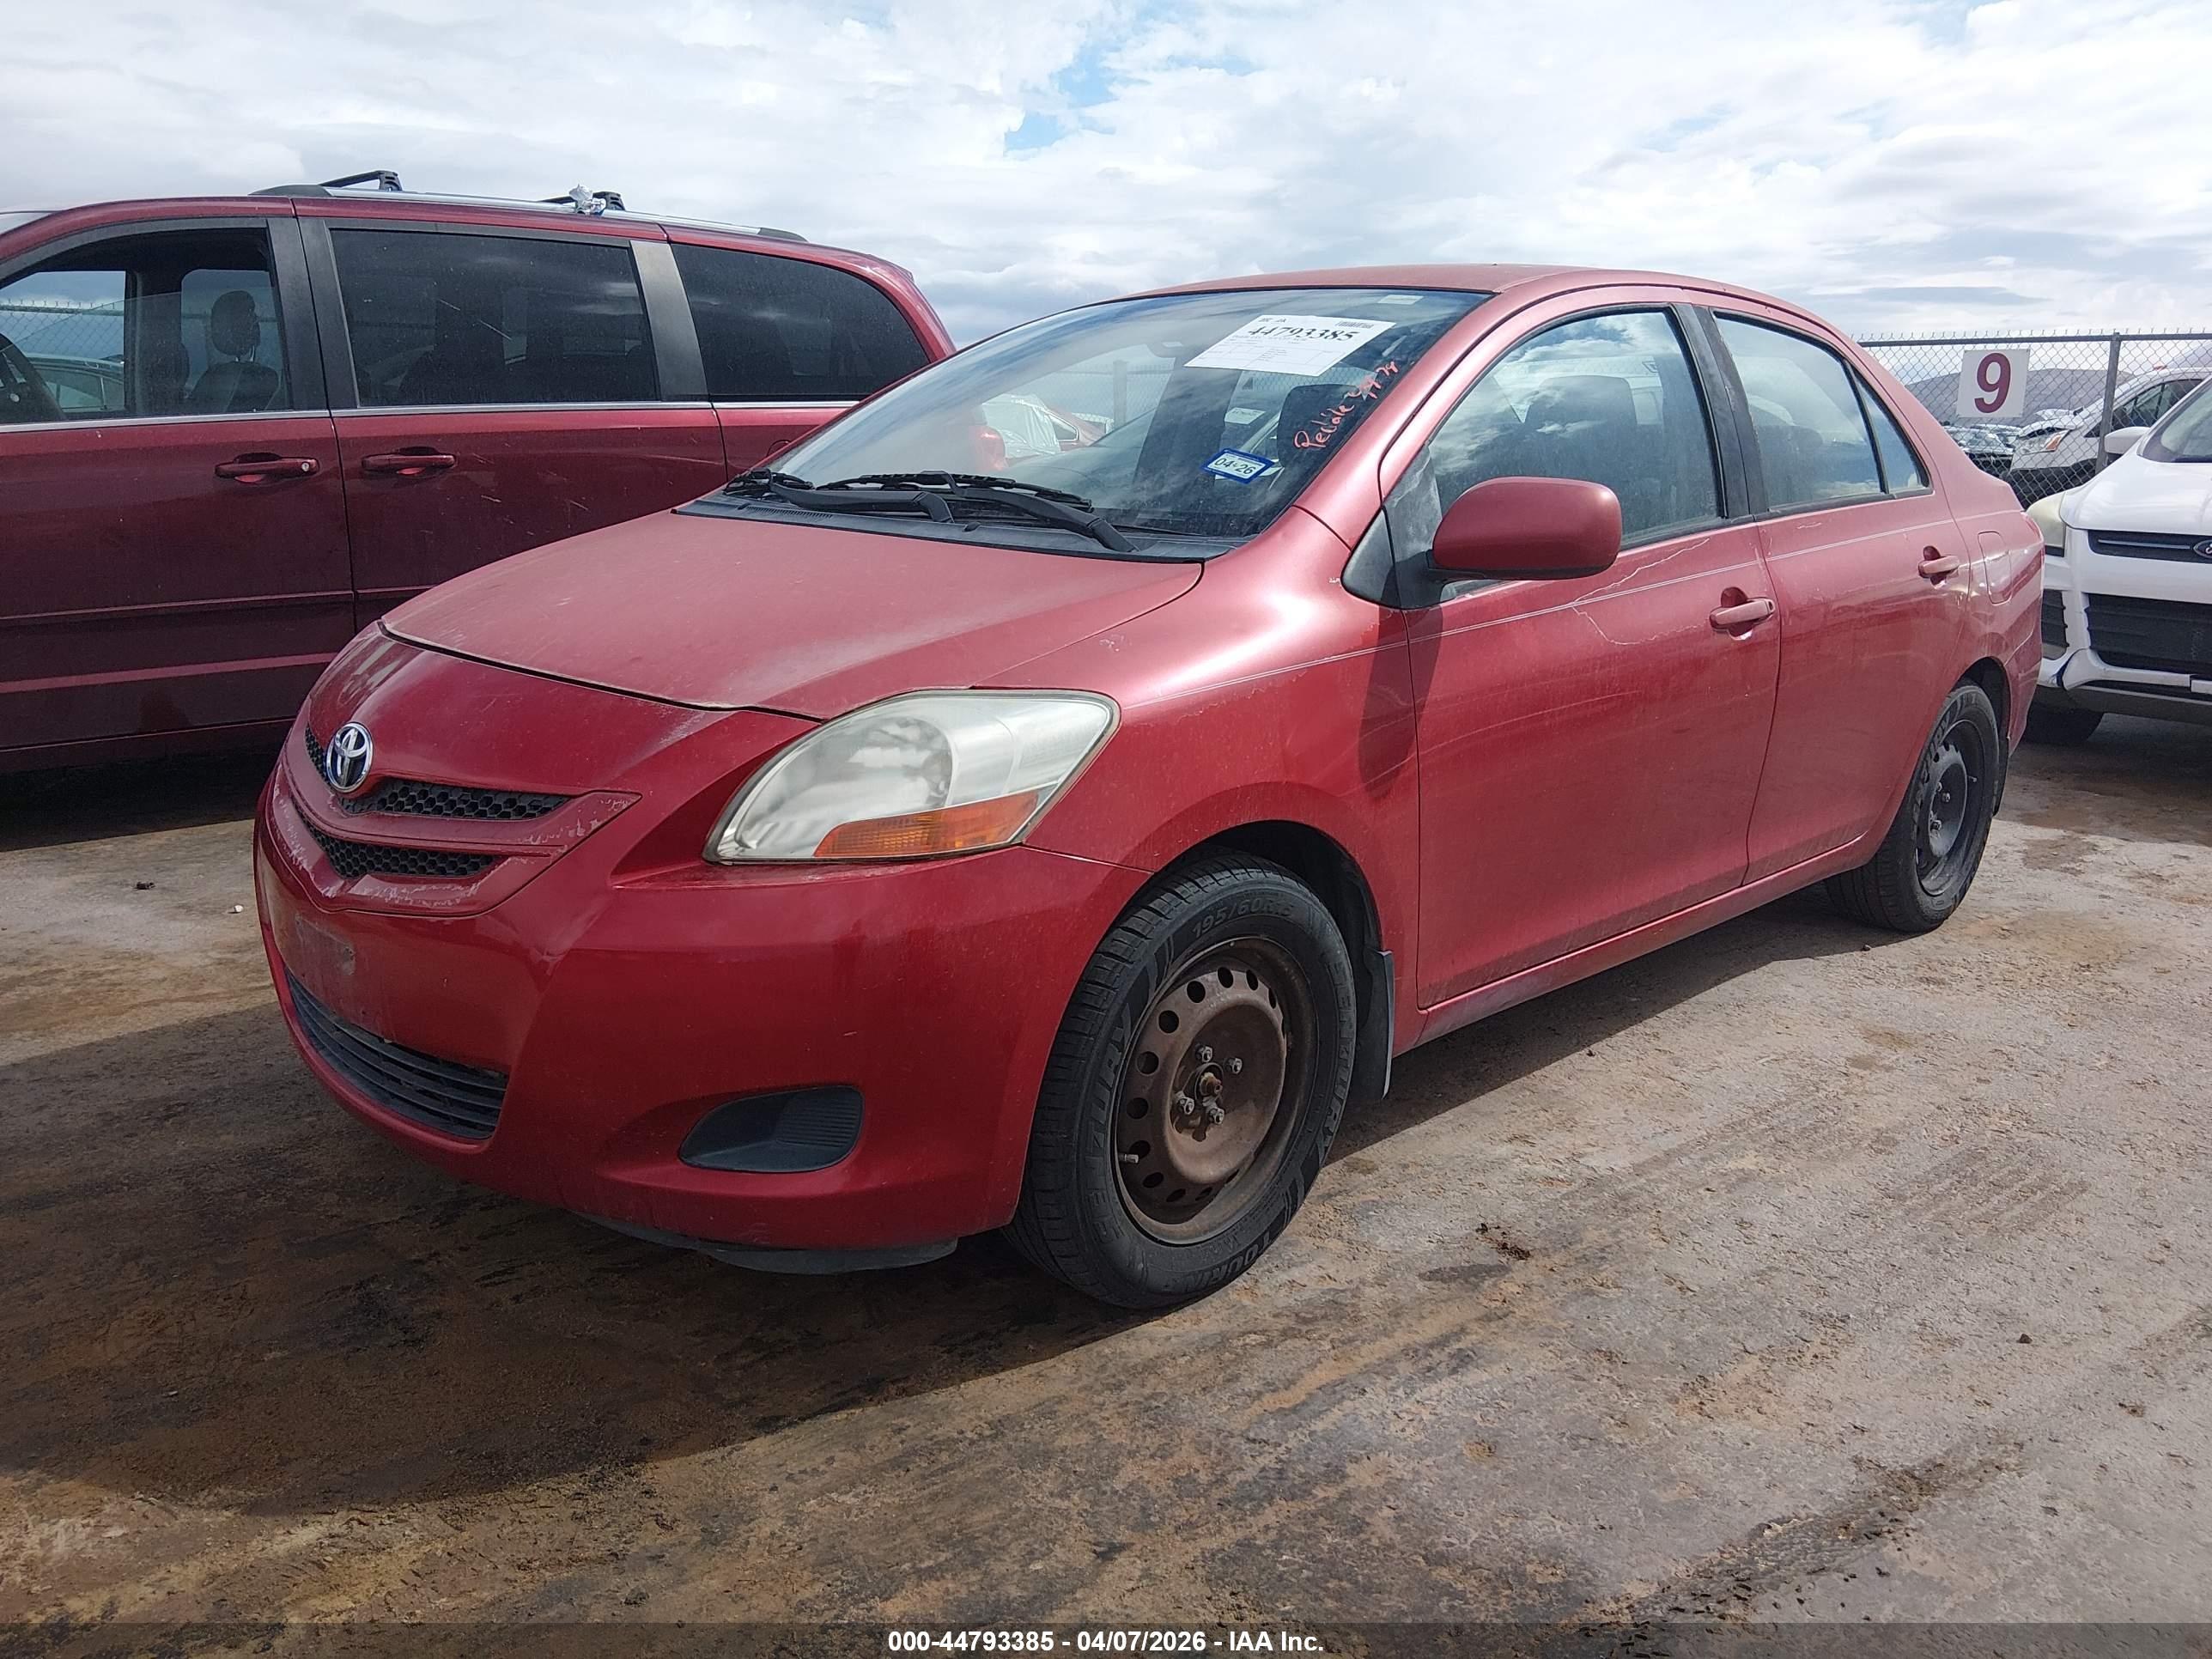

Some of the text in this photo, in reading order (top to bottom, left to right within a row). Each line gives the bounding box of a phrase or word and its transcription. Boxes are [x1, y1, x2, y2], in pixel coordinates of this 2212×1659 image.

[1247, 325, 1362, 342] 44793385
[1974, 352, 2011, 414] 9
[1214, 458, 1257, 476] 04 26
[1175, 1231, 1271, 1292] TOURIN
